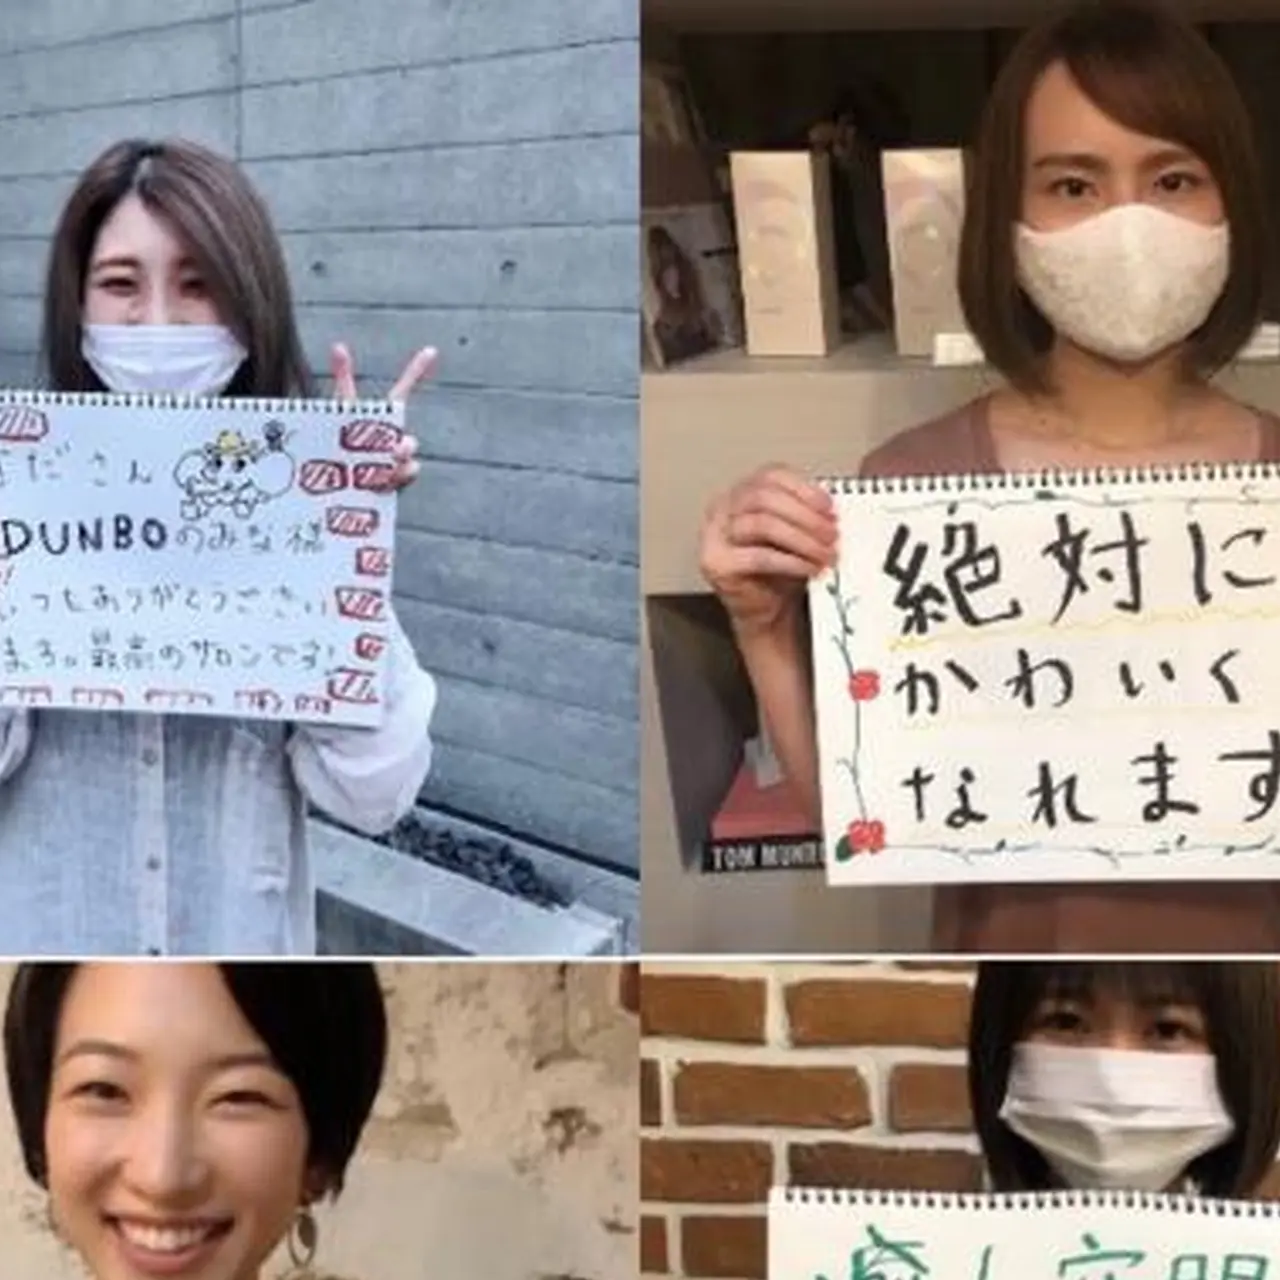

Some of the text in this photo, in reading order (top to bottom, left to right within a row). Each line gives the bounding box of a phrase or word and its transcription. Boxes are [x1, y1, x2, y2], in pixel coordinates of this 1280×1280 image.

[884, 501, 1278, 636] 絶対に
[894, 649, 1243, 716] かわいく
